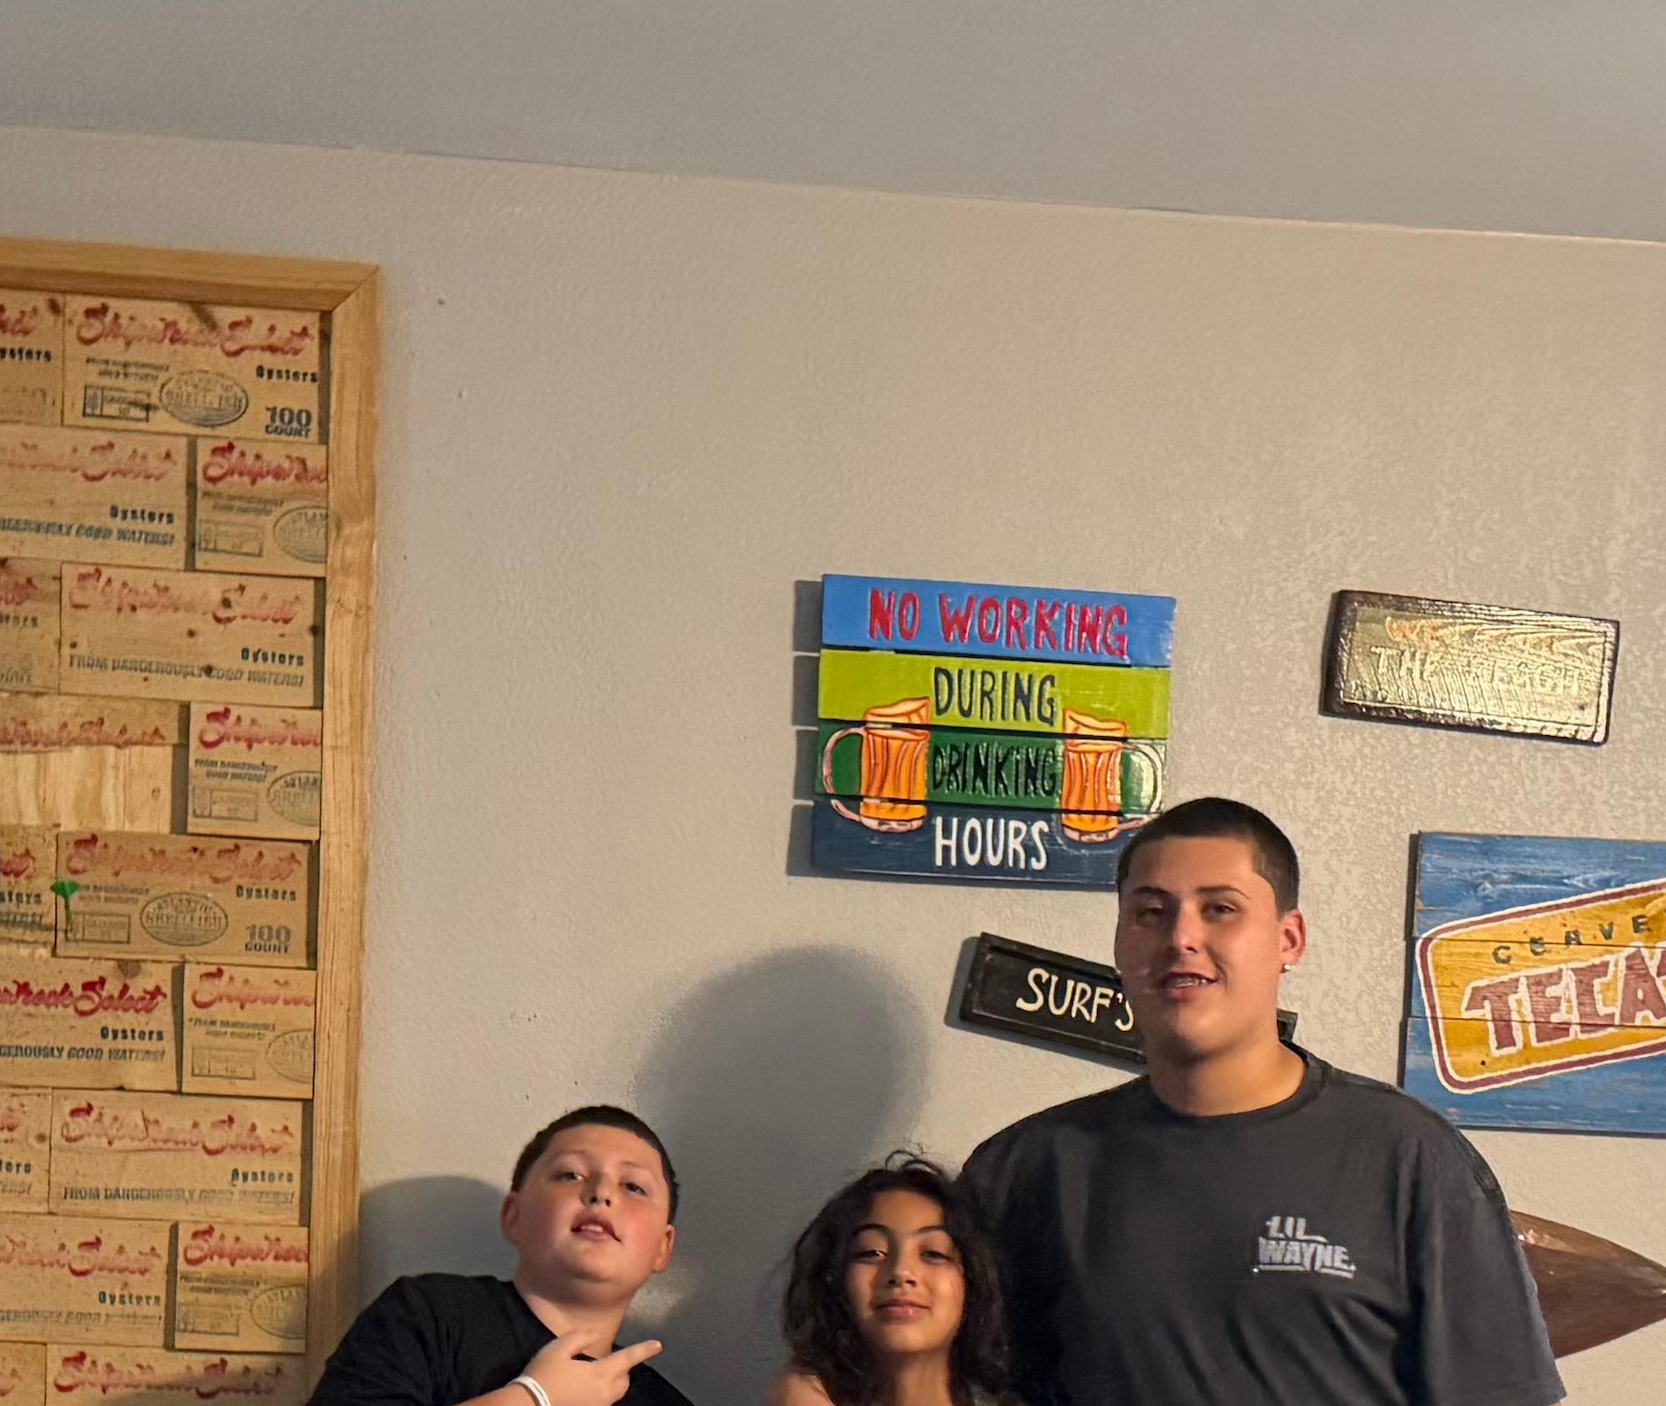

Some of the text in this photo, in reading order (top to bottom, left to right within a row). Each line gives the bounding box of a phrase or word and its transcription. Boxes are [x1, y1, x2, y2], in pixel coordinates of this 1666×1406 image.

[255, 364, 319, 384] Oysters
[266, 407, 312, 426] 100
[868, 588, 1129, 658] NO WORKING
[933, 667, 1057, 727] DURING
[932, 742, 1058, 797] DRINKING
[934, 816, 1049, 870] HOURS
[236, 884, 297, 902] Oysters
[1016, 967, 1135, 1032] SURF'S
[100, 1027, 164, 1043] Oysters
[1265, 1216, 1329, 1242] LIL
[1258, 1237, 1356, 1272] WAYNE
